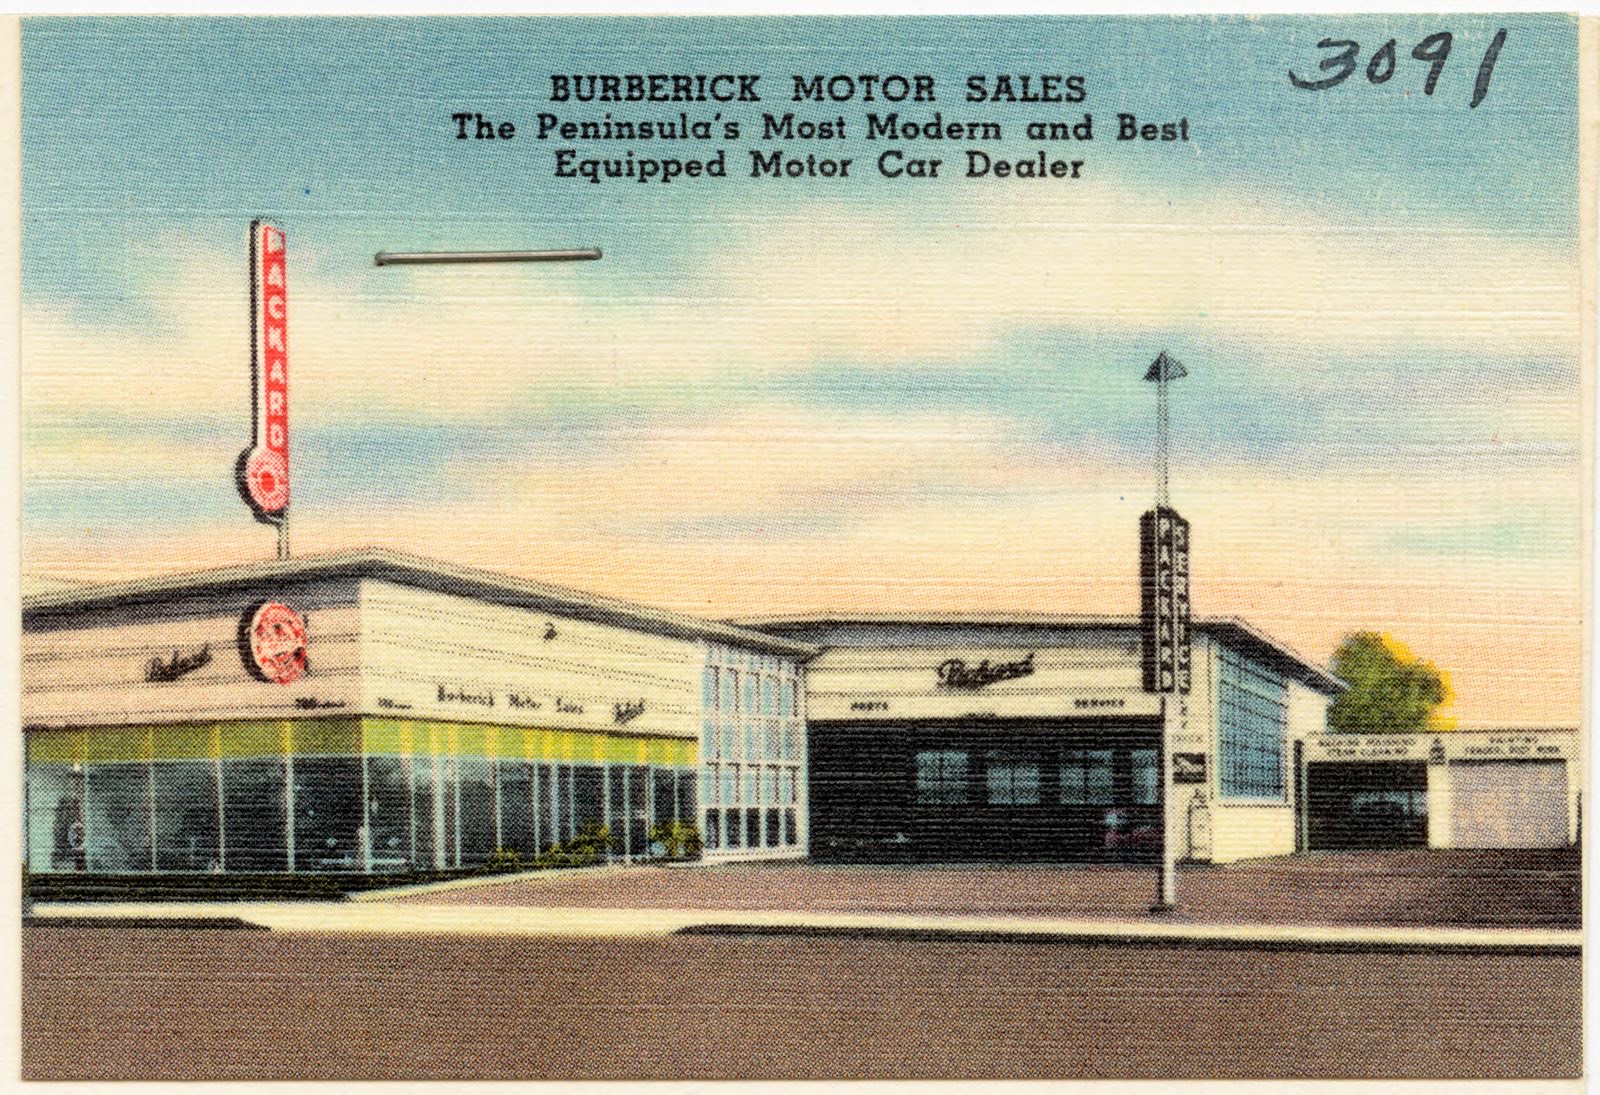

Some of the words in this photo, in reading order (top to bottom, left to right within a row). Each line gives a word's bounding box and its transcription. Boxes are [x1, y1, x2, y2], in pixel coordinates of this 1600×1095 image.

[1289, 28, 1507, 108] 3091
[266, 229, 286, 448] PACKARD
[1159, 516, 1173, 688] PACKARD
